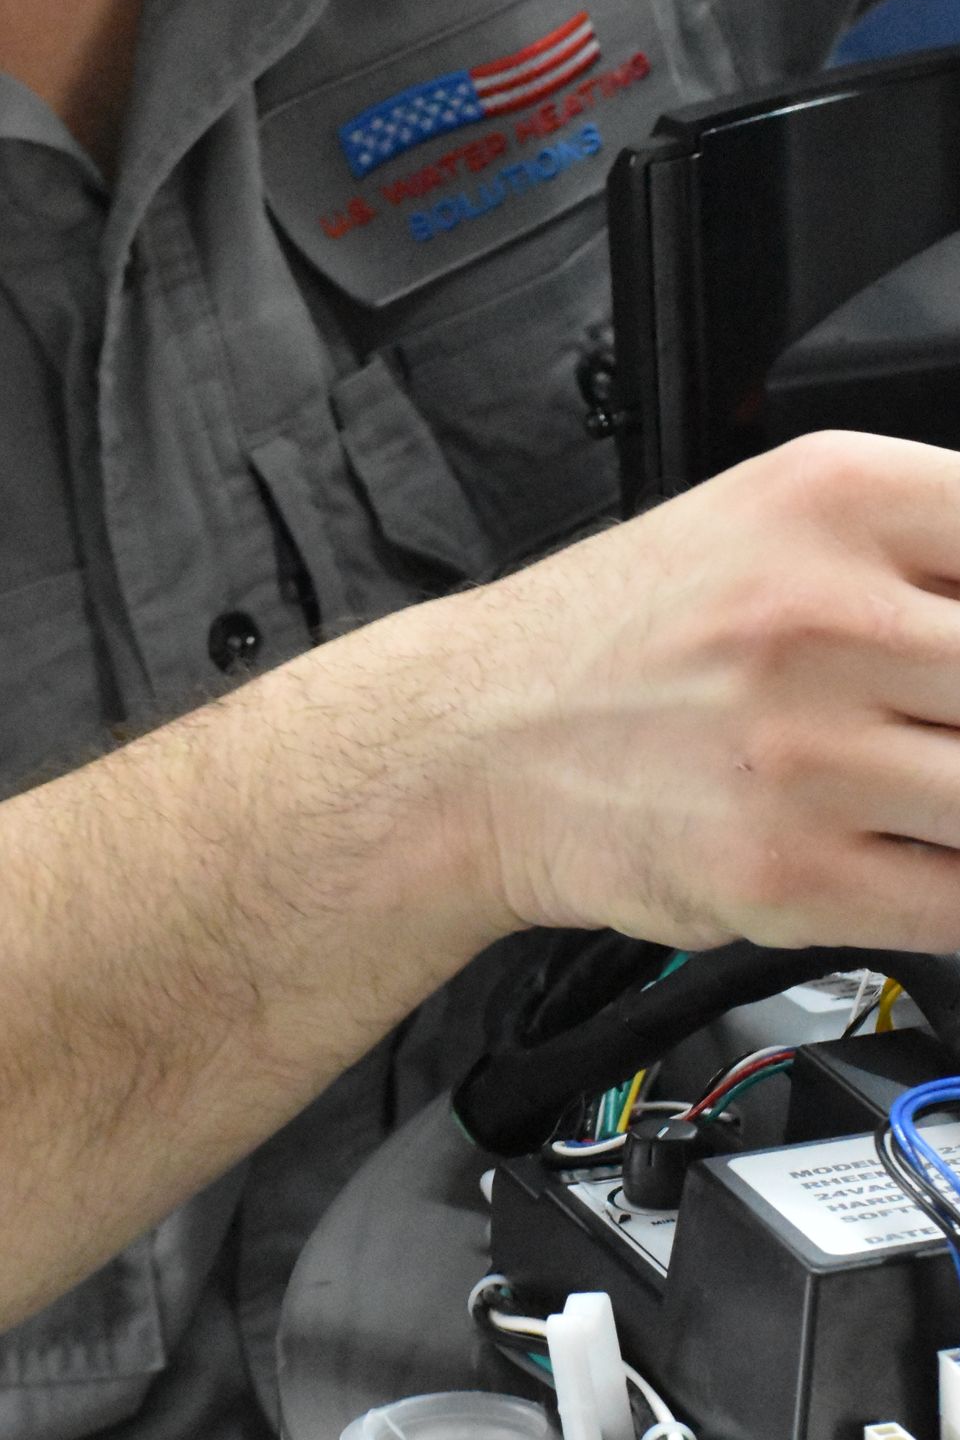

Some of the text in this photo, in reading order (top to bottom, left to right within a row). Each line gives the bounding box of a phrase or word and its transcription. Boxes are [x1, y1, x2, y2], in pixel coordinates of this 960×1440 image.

[380, 131, 508, 205] WATER
[514, 51, 651, 144] HEATING
[409, 122, 602, 243] SOLUTIONS
[864, 1227, 939, 1244] DATE
